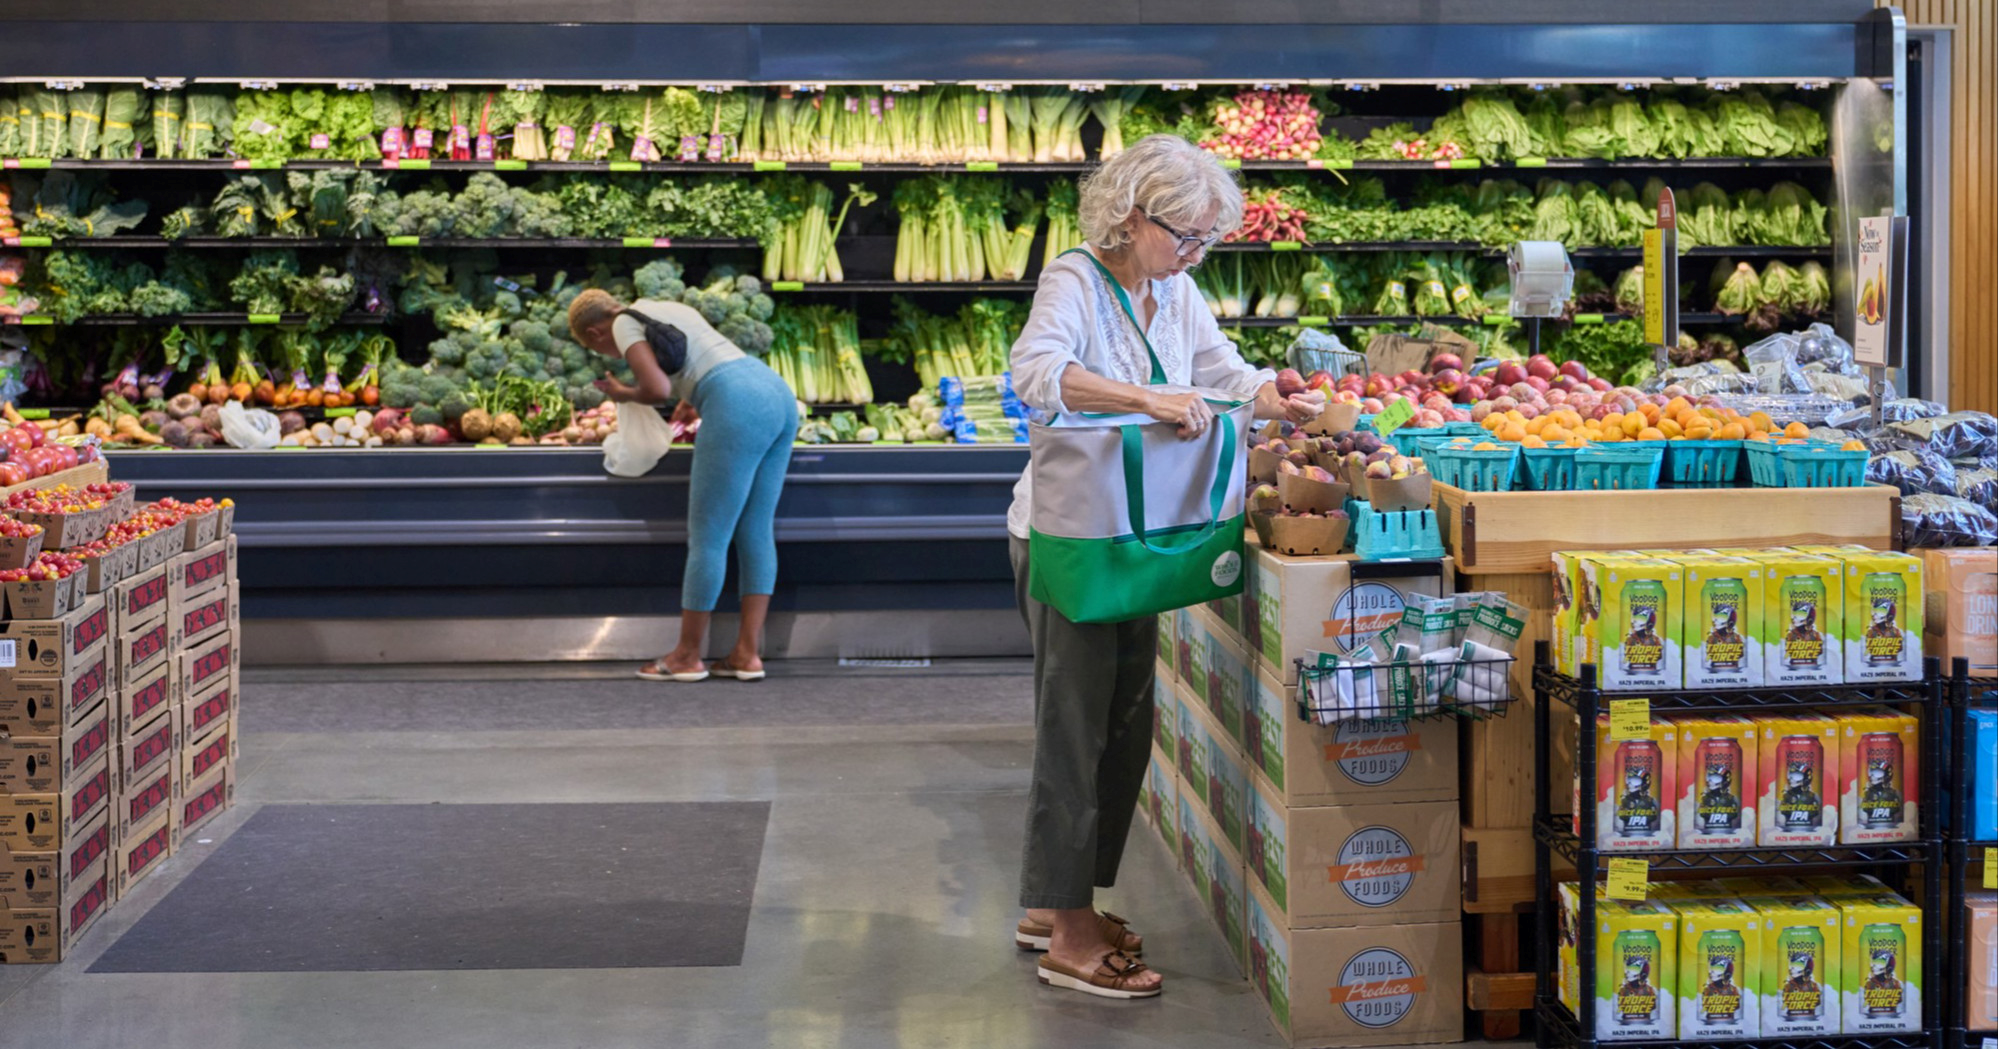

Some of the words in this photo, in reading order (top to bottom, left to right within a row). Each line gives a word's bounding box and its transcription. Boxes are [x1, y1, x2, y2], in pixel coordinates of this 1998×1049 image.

[1789, 590, 1817, 599] VOODOO
[1870, 587, 1898, 596] VOODOO
[1346, 595, 1397, 609] WHOLE
[1628, 593, 1658, 603] VOODOO
[1710, 592, 1738, 602] VOODOO
[1424, 620, 1443, 630] PRODUCE
[1477, 612, 1500, 628] PRODUCE
[1500, 622, 1519, 636] SACKS
[1786, 640, 1823, 650] TROPIC
[1866, 638, 1903, 647] TROPIC
[1625, 644, 1662, 654] TROPIC
[1707, 644, 1744, 653] TROPIC
[1865, 646, 1900, 656] FORCE
[1625, 654, 1660, 664] FORCE
[1707, 652, 1740, 662] FORCE
[1785, 650, 1820, 660] FORCE
[1341, 736, 1404, 758] Produce
[1351, 759, 1398, 775] FOODS
[1790, 811, 1808, 821] IPA
[1872, 808, 1890, 818] IPA
[1628, 816, 1647, 826] IPA
[1708, 814, 1728, 824] IPA
[1351, 840, 1403, 855] WHOLE
[1344, 855, 1408, 880] Produce
[1354, 880, 1400, 896] FOODS
[1786, 941, 1816, 950] VOODOO
[1868, 938, 1897, 947] VOODOO
[1622, 945, 1652, 954] VOODOO
[1706, 945, 1736, 954] VOODOO
[1353, 961, 1404, 976] WHOLE
[1346, 976, 1409, 1000] Produce
[1784, 992, 1820, 1001] TROPIC
[1864, 989, 1902, 998] TROPIC
[1618, 996, 1655, 1005] TROPIC
[1702, 996, 1740, 1005] TROPIC
[1782, 1000, 1816, 1010] FORCE
[1864, 998, 1898, 1007] FORCE
[1356, 1002, 1402, 1017] FOODS
[1618, 1004, 1652, 1014] FORCE
[1702, 1004, 1736, 1014] FORCE
